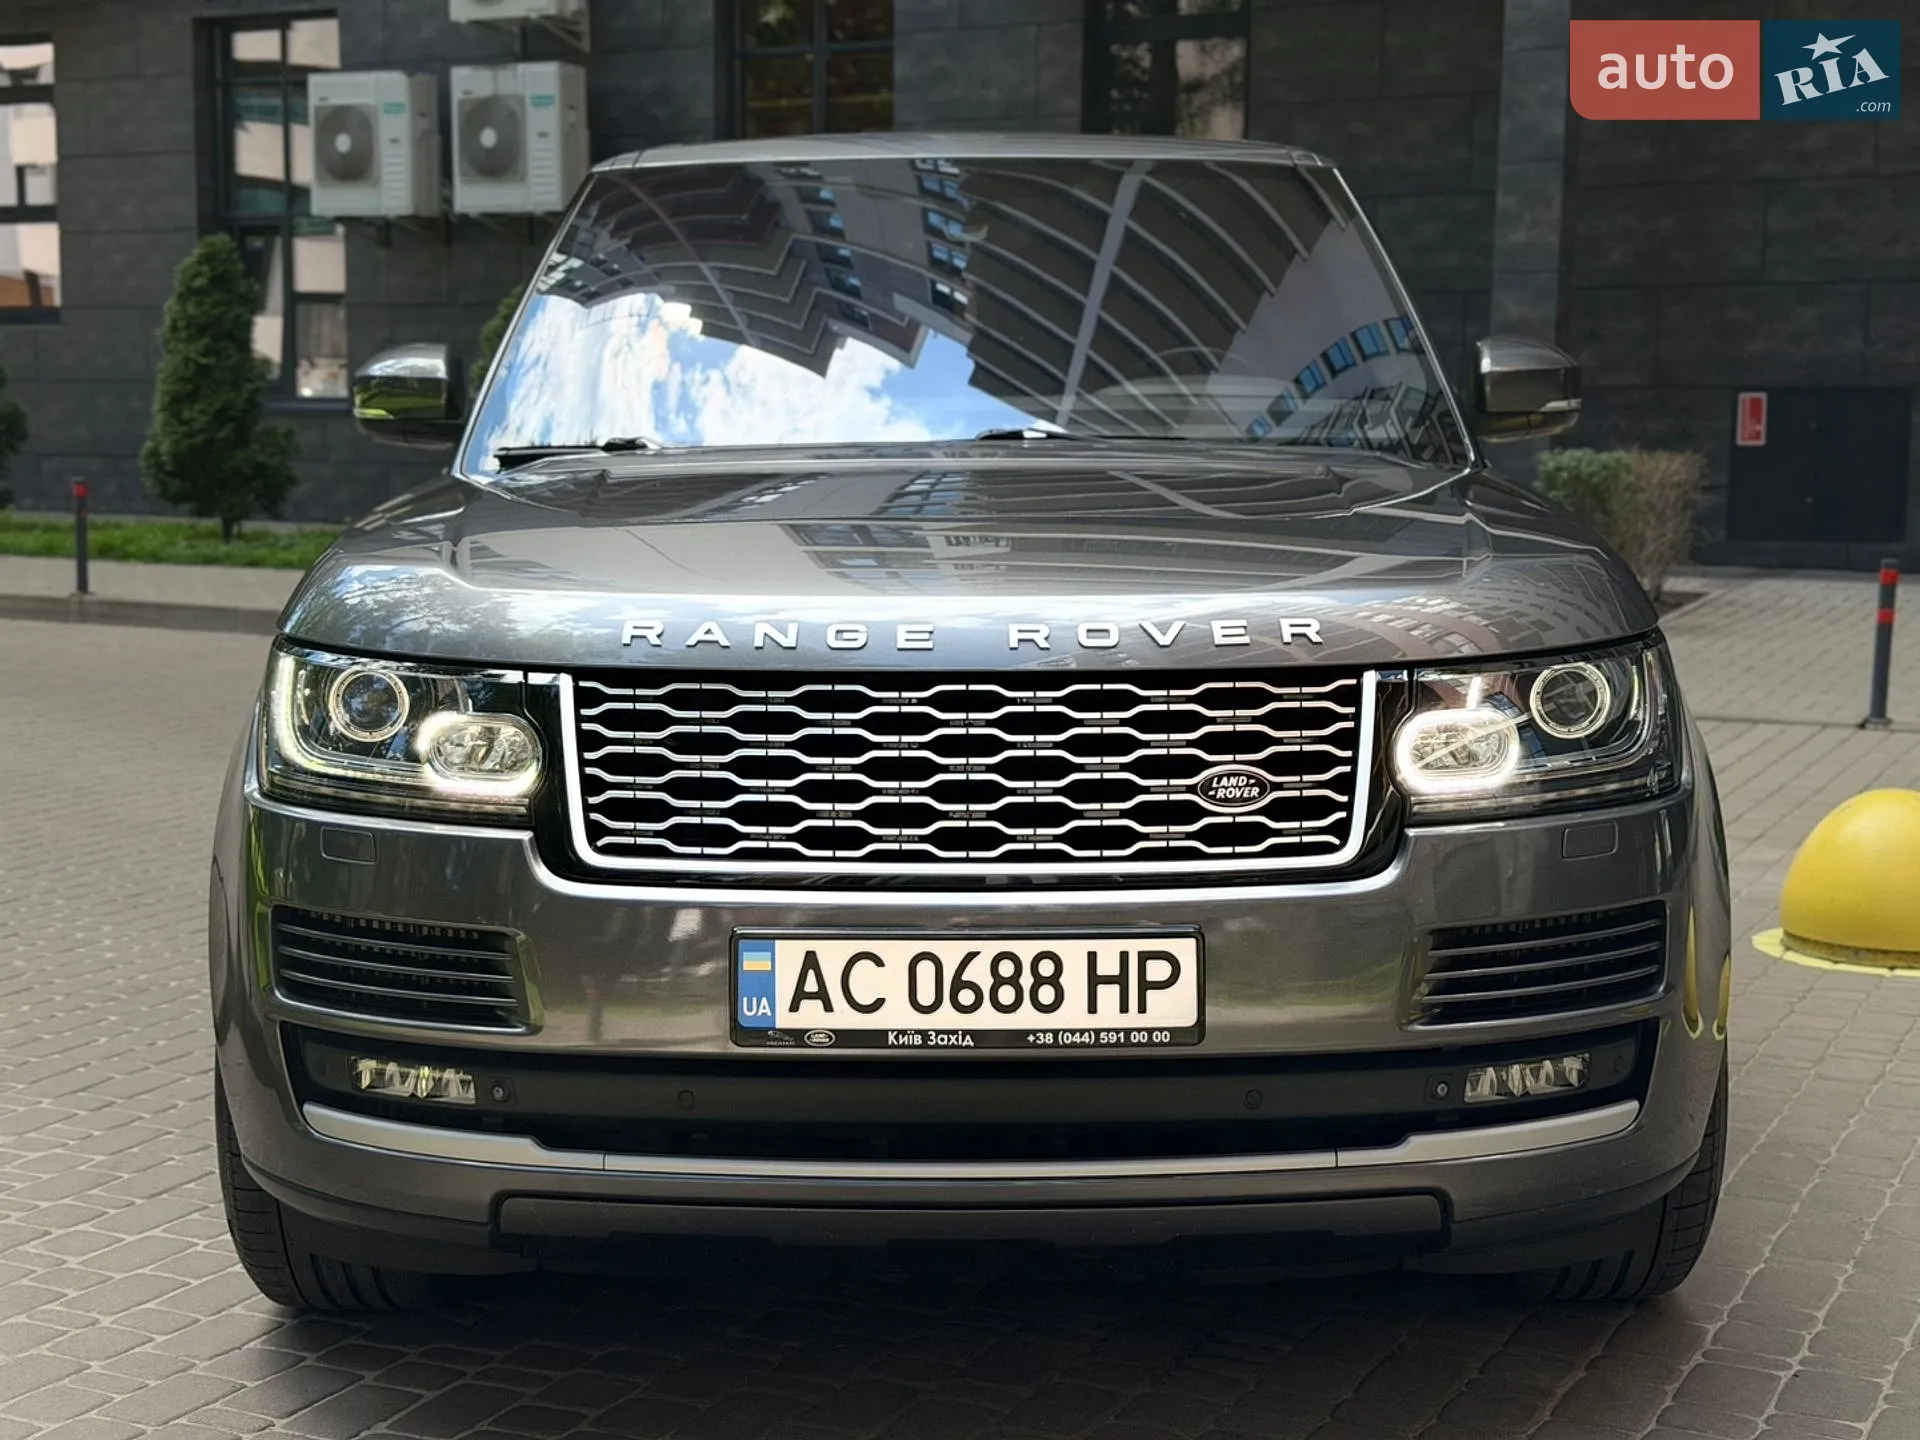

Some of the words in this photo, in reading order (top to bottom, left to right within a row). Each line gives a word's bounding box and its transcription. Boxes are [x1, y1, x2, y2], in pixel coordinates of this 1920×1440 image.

[621, 620, 934, 650] RANGE
[1008, 617, 1324, 649] ROVER
[789, 951, 886, 1013] AC
[908, 951, 1064, 1014] 0688
[1087, 951, 1181, 1013] HP
[743, 997, 772, 1016] UA
[888, 1031, 922, 1045] Київ
[927, 1031, 975, 1047] Захід
[1027, 1032, 1053, 1044] +38
[1058, 1031, 1095, 1045] (044)
[1100, 1032, 1125, 1043] 591
[1130, 1031, 1148, 1043] 00
[1152, 1031, 1171, 1043] 00
